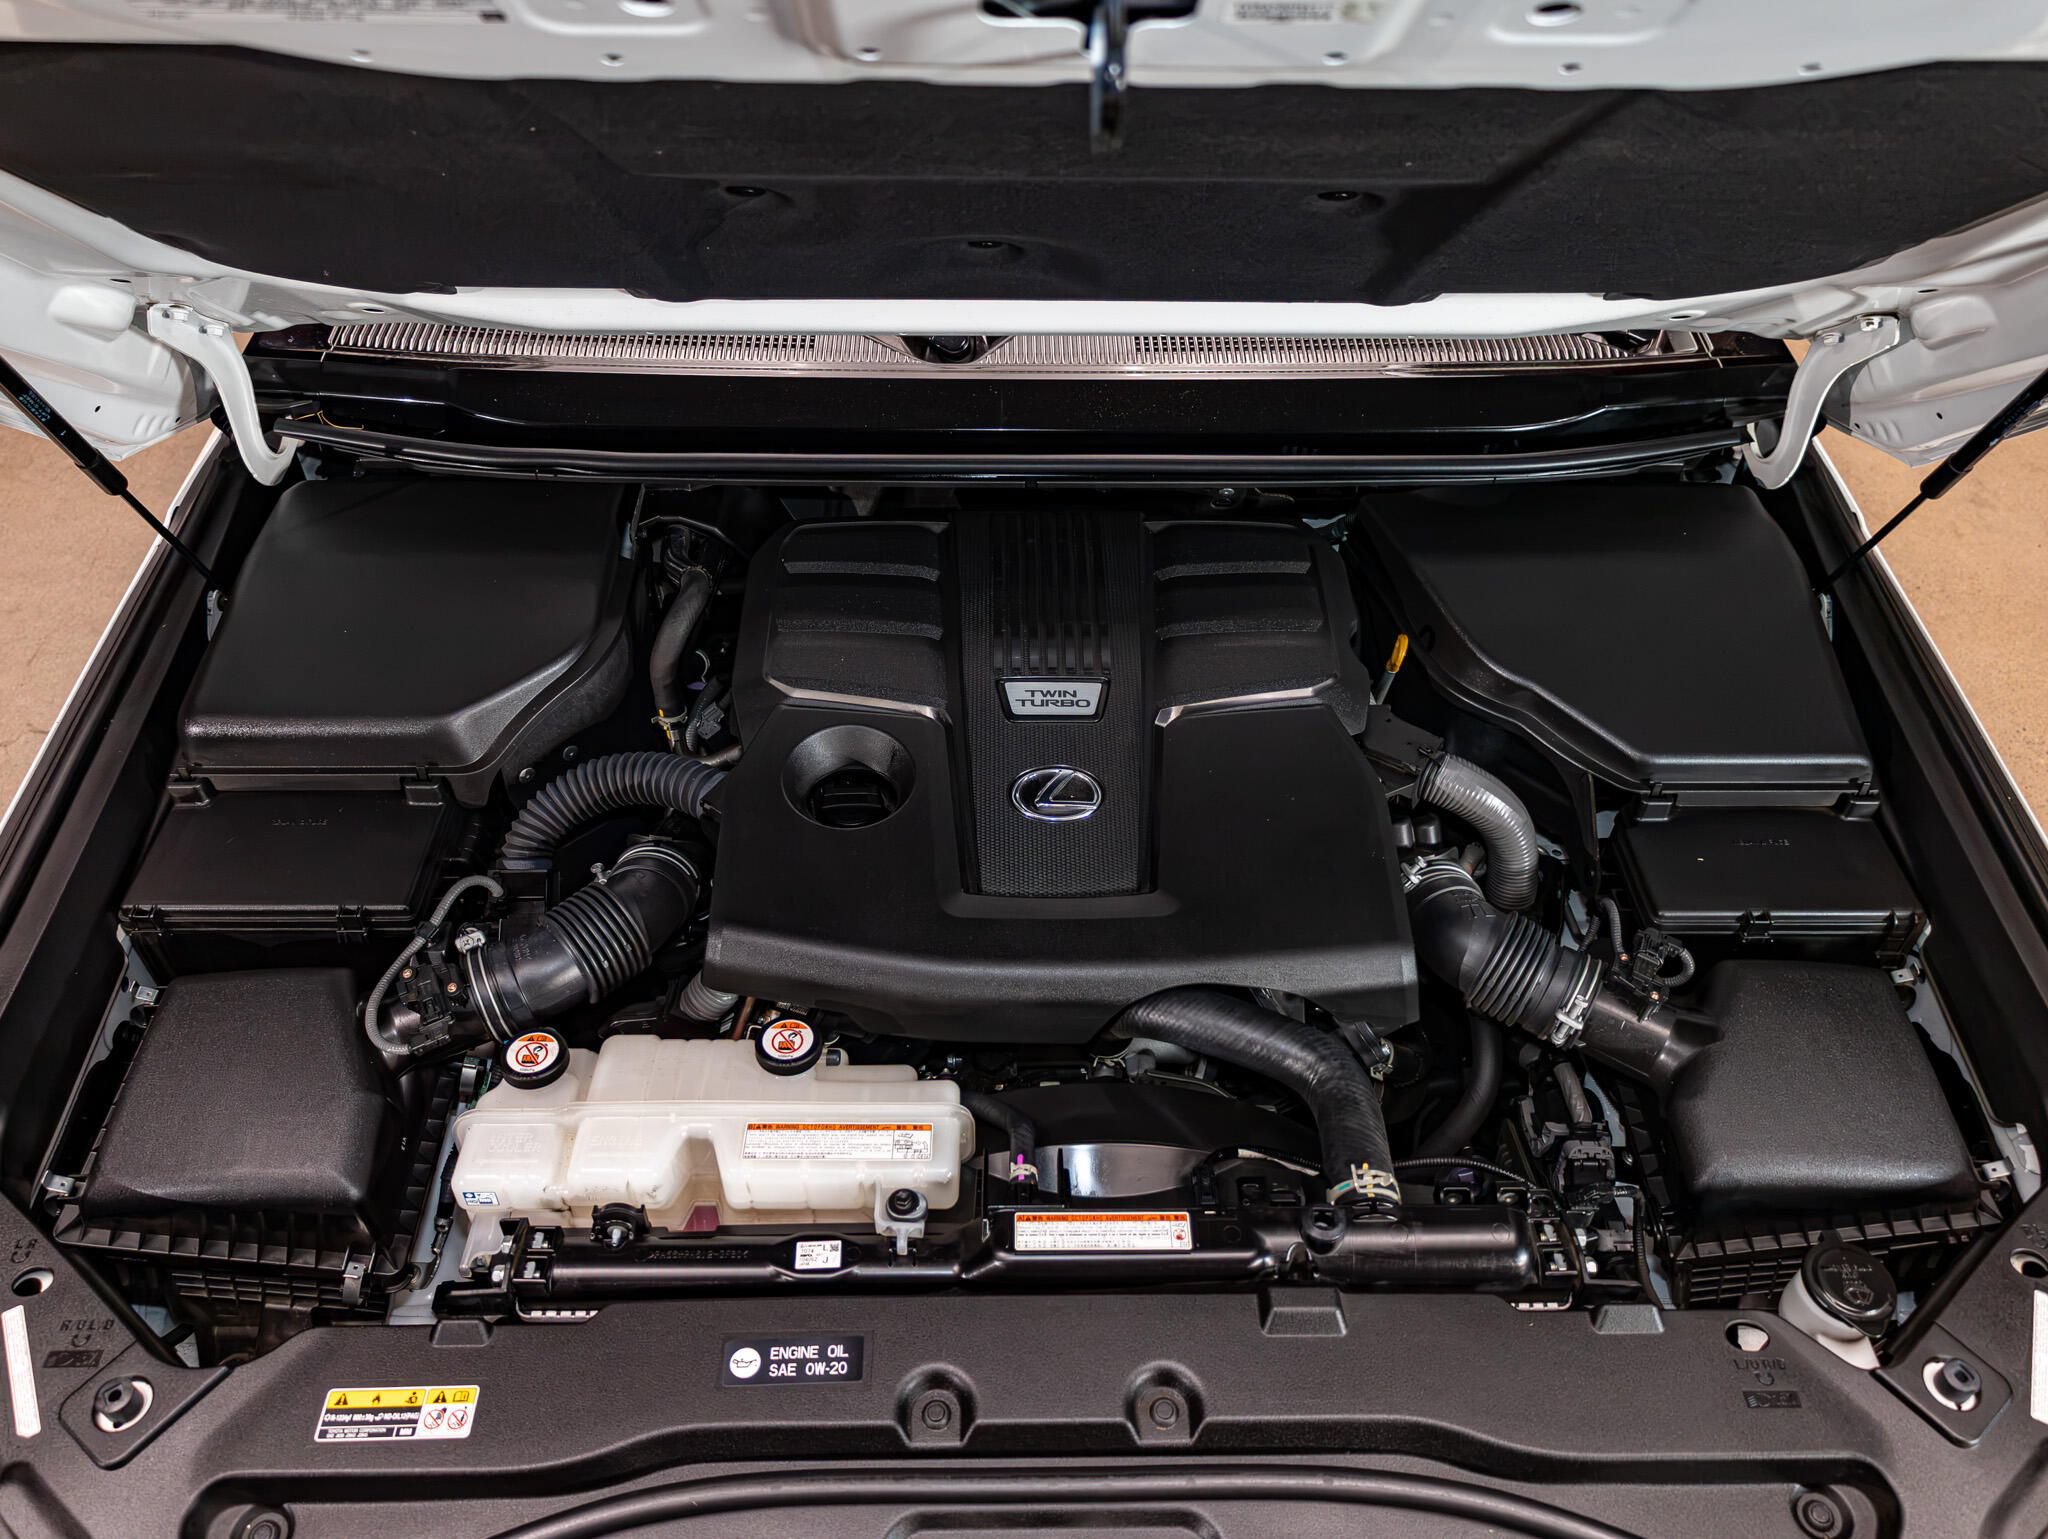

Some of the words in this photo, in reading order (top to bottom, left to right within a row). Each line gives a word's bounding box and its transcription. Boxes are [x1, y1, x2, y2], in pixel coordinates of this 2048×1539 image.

[1024, 689, 1077, 698] TWIN
[1015, 699, 1091, 708] TURBO
[769, 1345, 820, 1360] ENGINE
[827, 1344, 849, 1358] OIL
[768, 1363, 797, 1377] SAE
[805, 1361, 848, 1376] 0W-20
